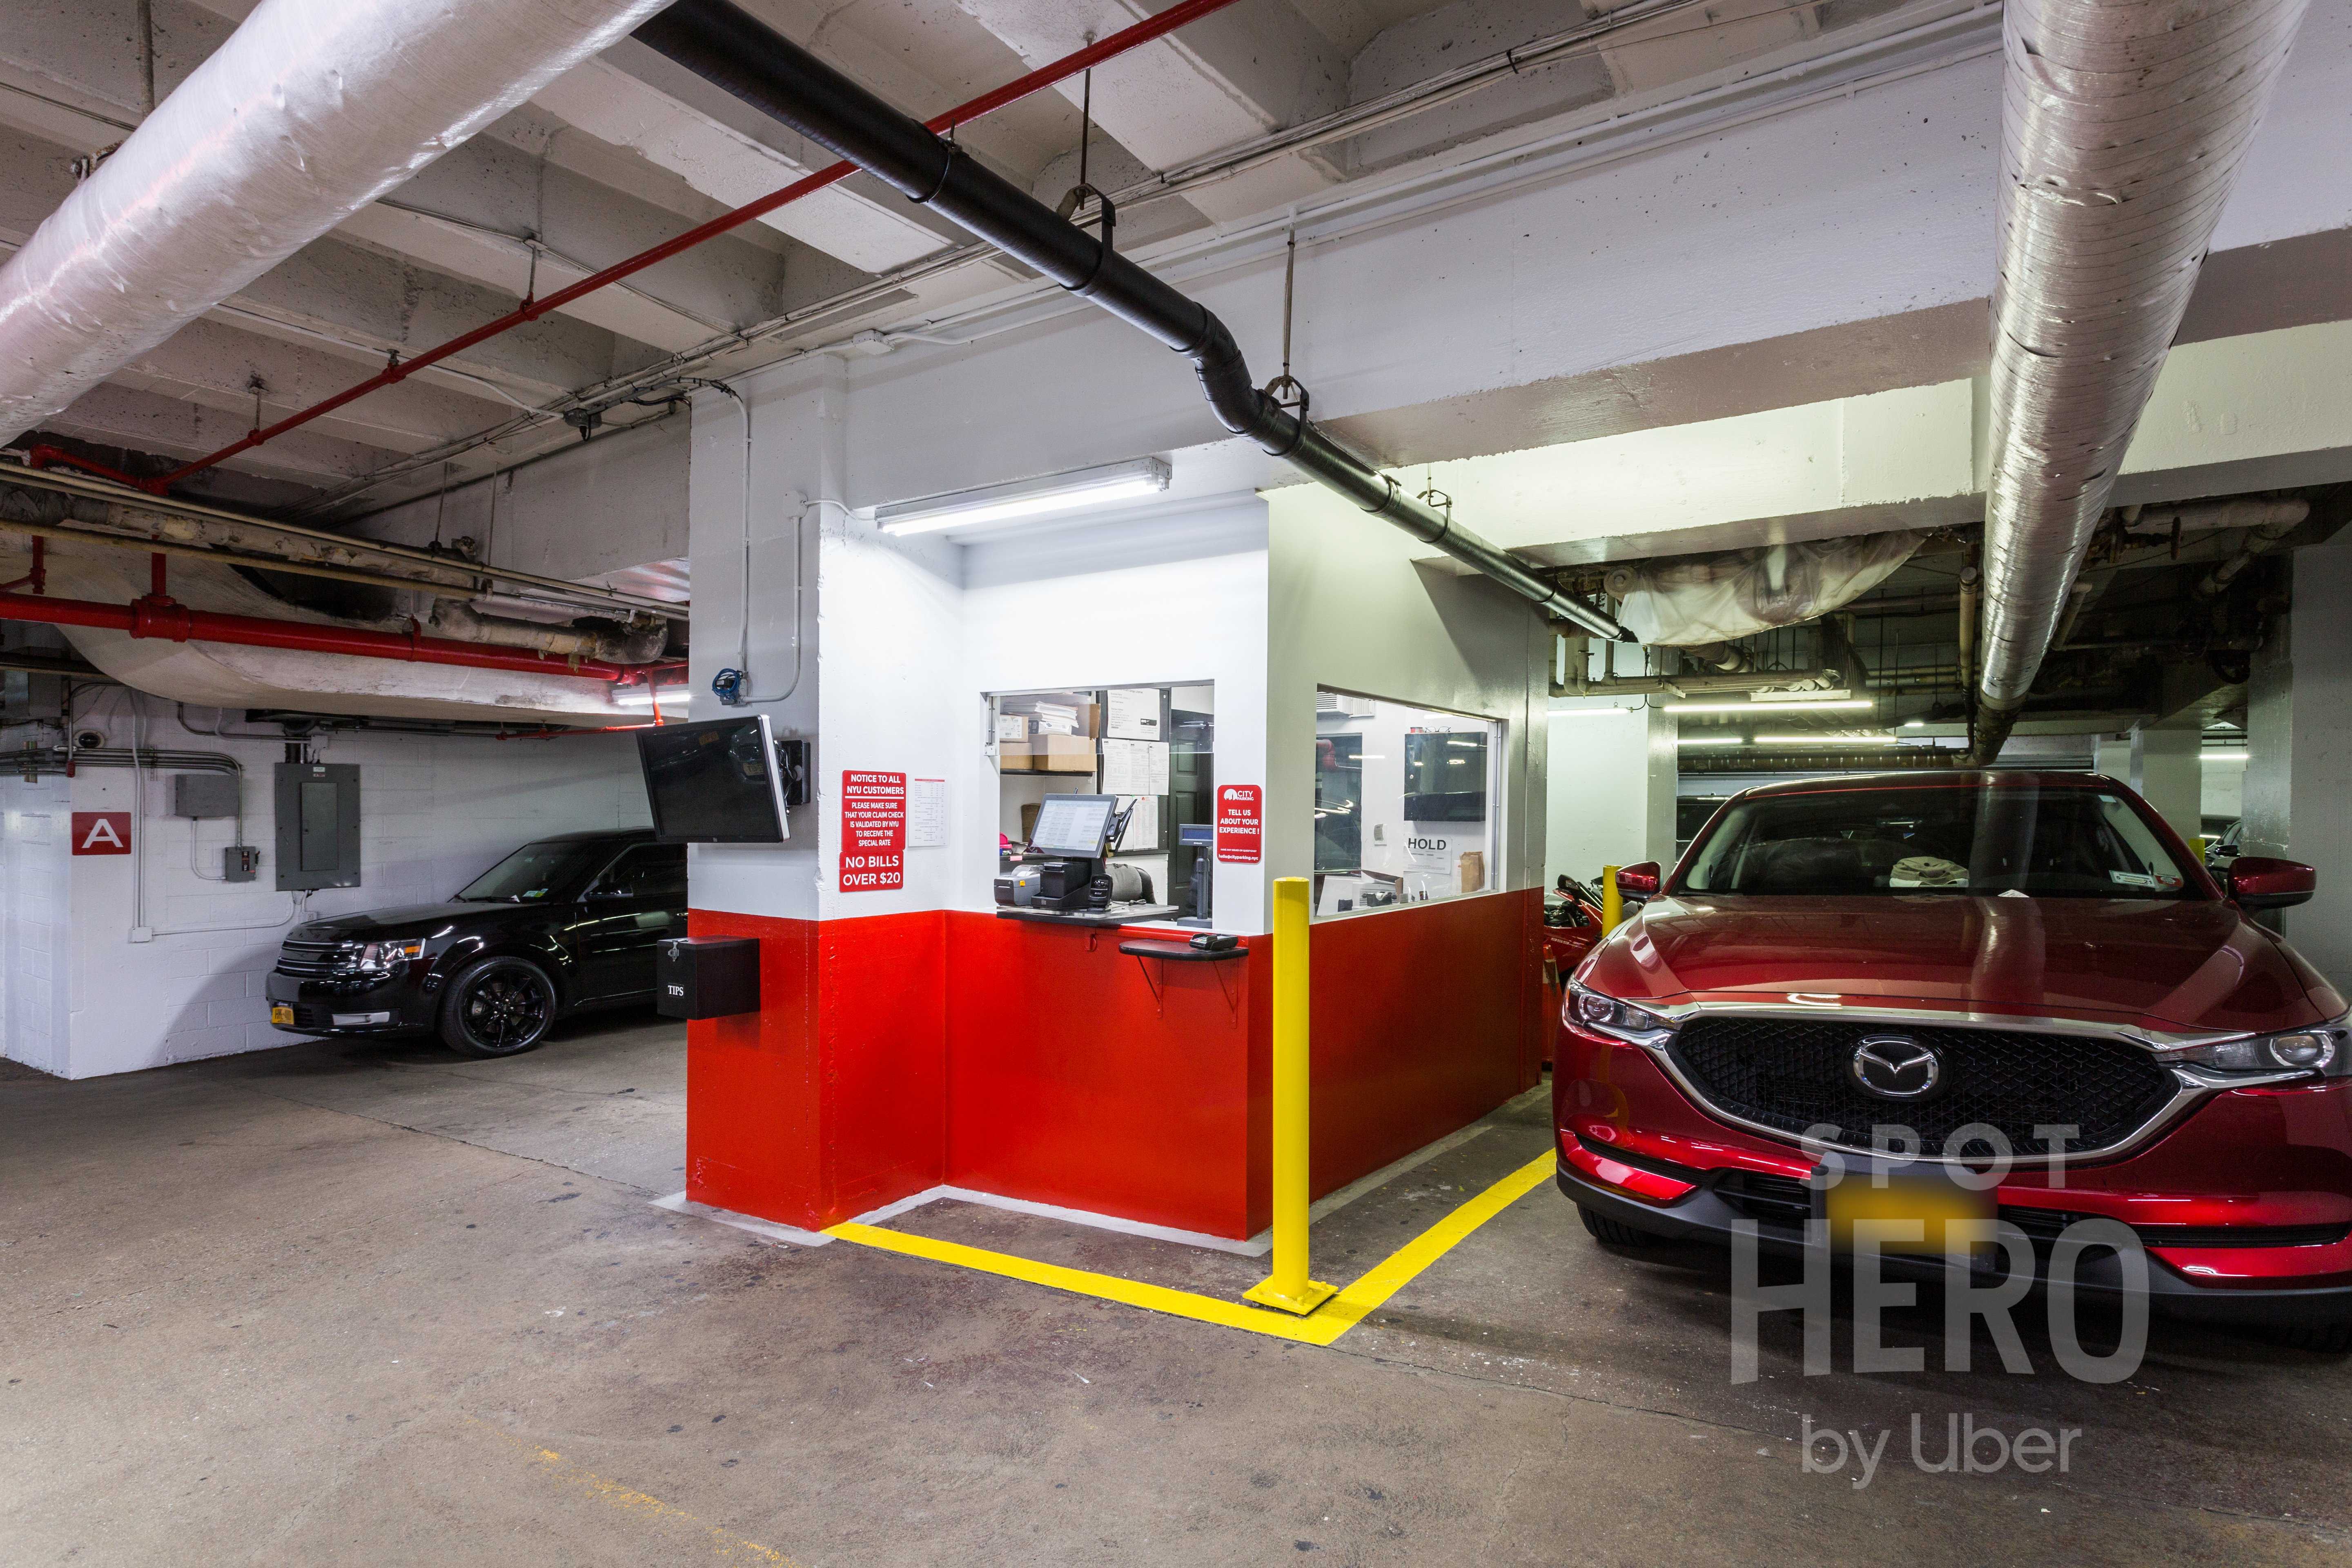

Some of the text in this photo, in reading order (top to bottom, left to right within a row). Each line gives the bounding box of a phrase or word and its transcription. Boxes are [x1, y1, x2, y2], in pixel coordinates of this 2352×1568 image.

[851, 774, 877, 782] NOTICE
[863, 786, 904, 794] CUSTOMERS
[81, 818, 124, 848] A
[1408, 837, 1446, 850] HOLD
[846, 855, 899, 868] NO BILLS
[843, 872, 901, 886] OVER $20
[668, 985, 684, 996] TIPS
